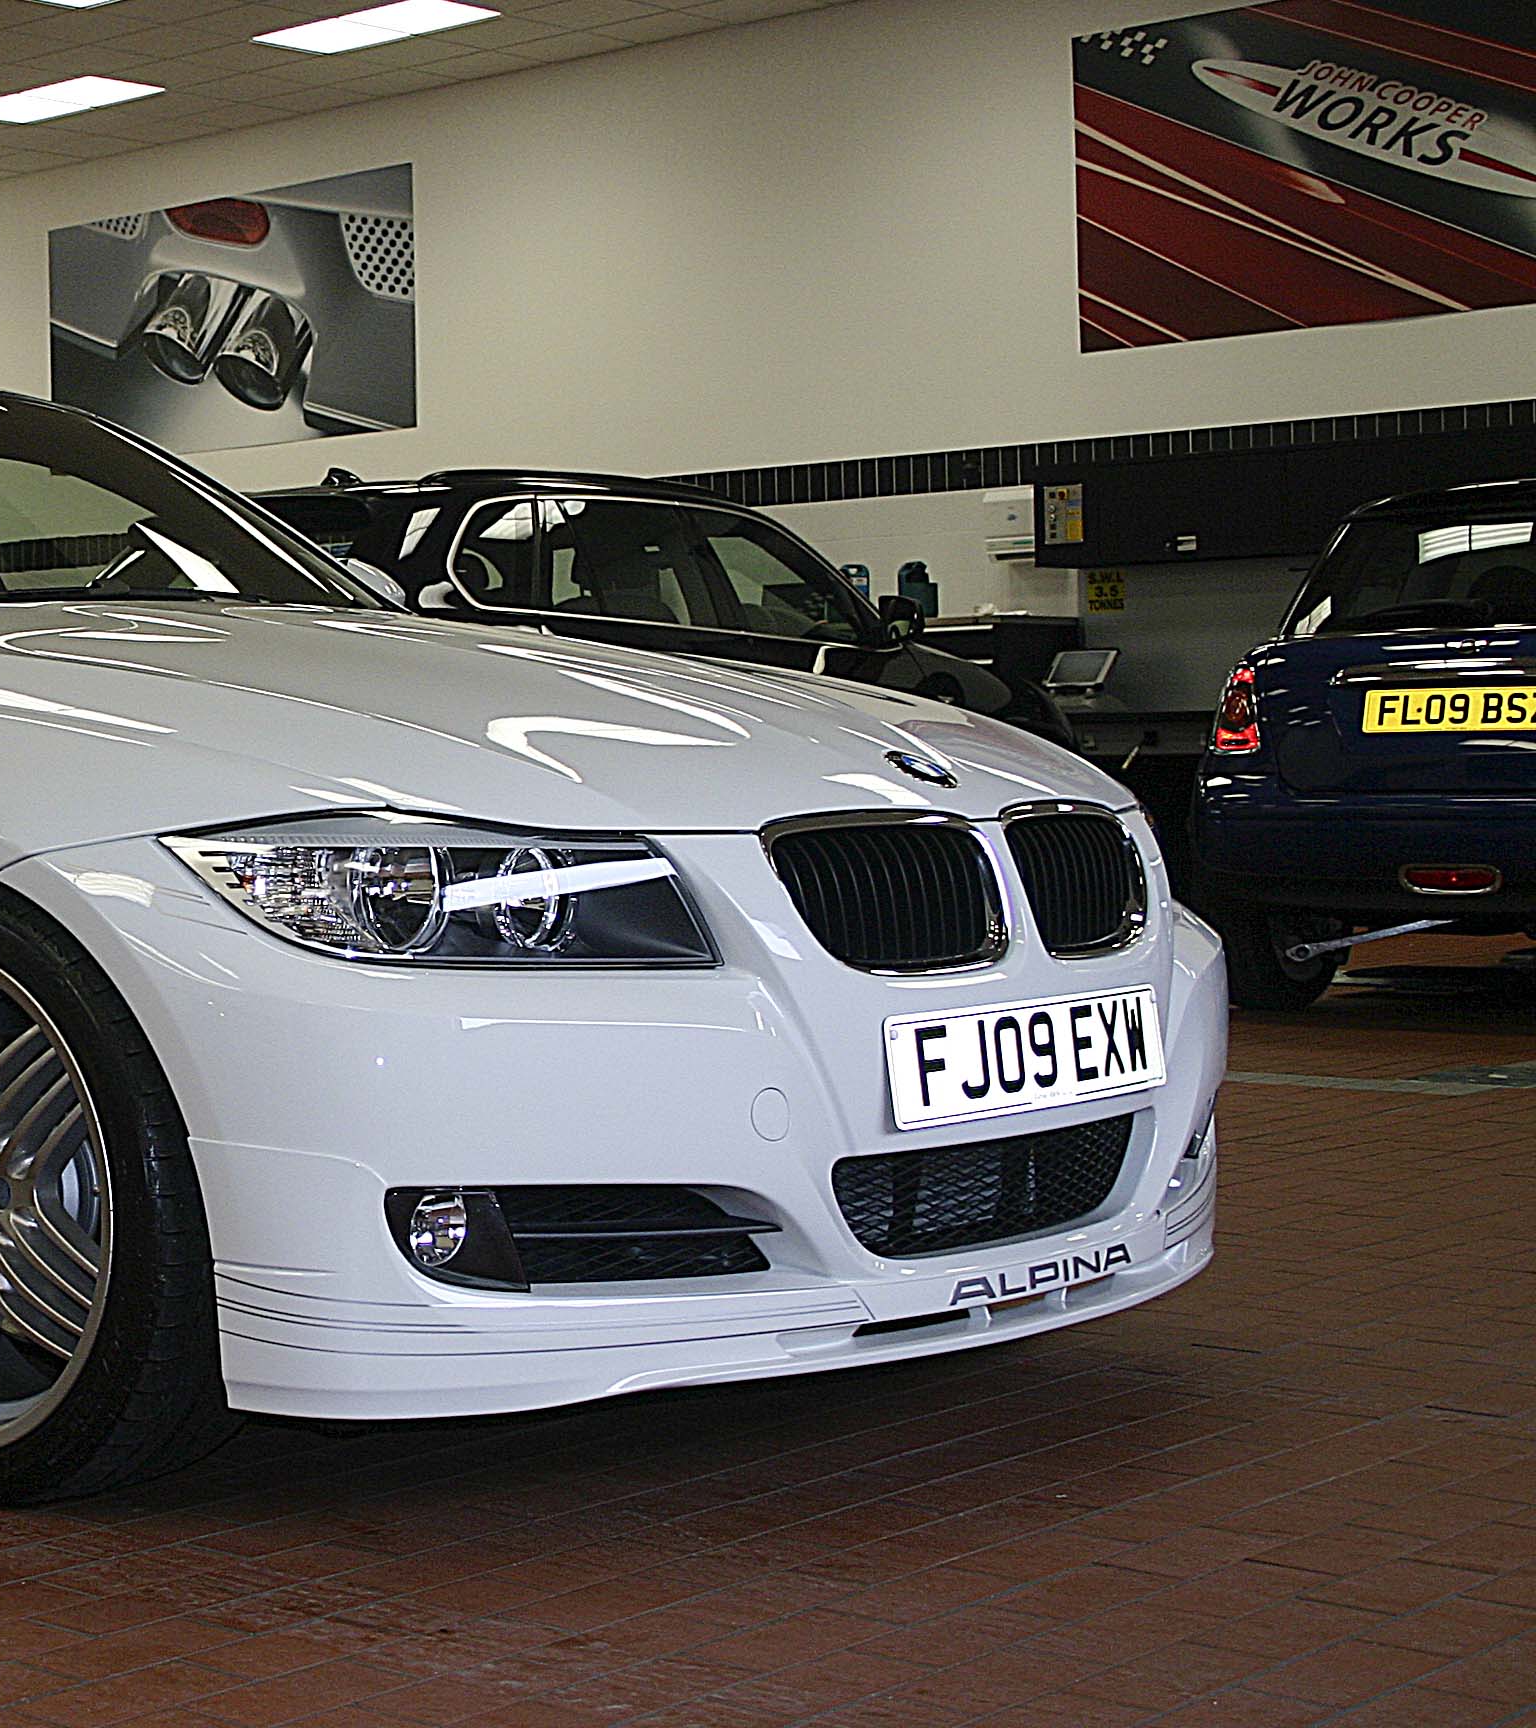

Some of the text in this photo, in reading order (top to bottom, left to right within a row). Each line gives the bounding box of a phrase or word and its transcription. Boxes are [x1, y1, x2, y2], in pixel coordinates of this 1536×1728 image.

[1272, 78, 1472, 166] WORKS
[1297, 61, 1485, 131] JOHN COOPER
[1480, 692, 1536, 724] BS
[1069, 996, 1148, 1083] EXW
[948, 1242, 1133, 1306] ALPINA
